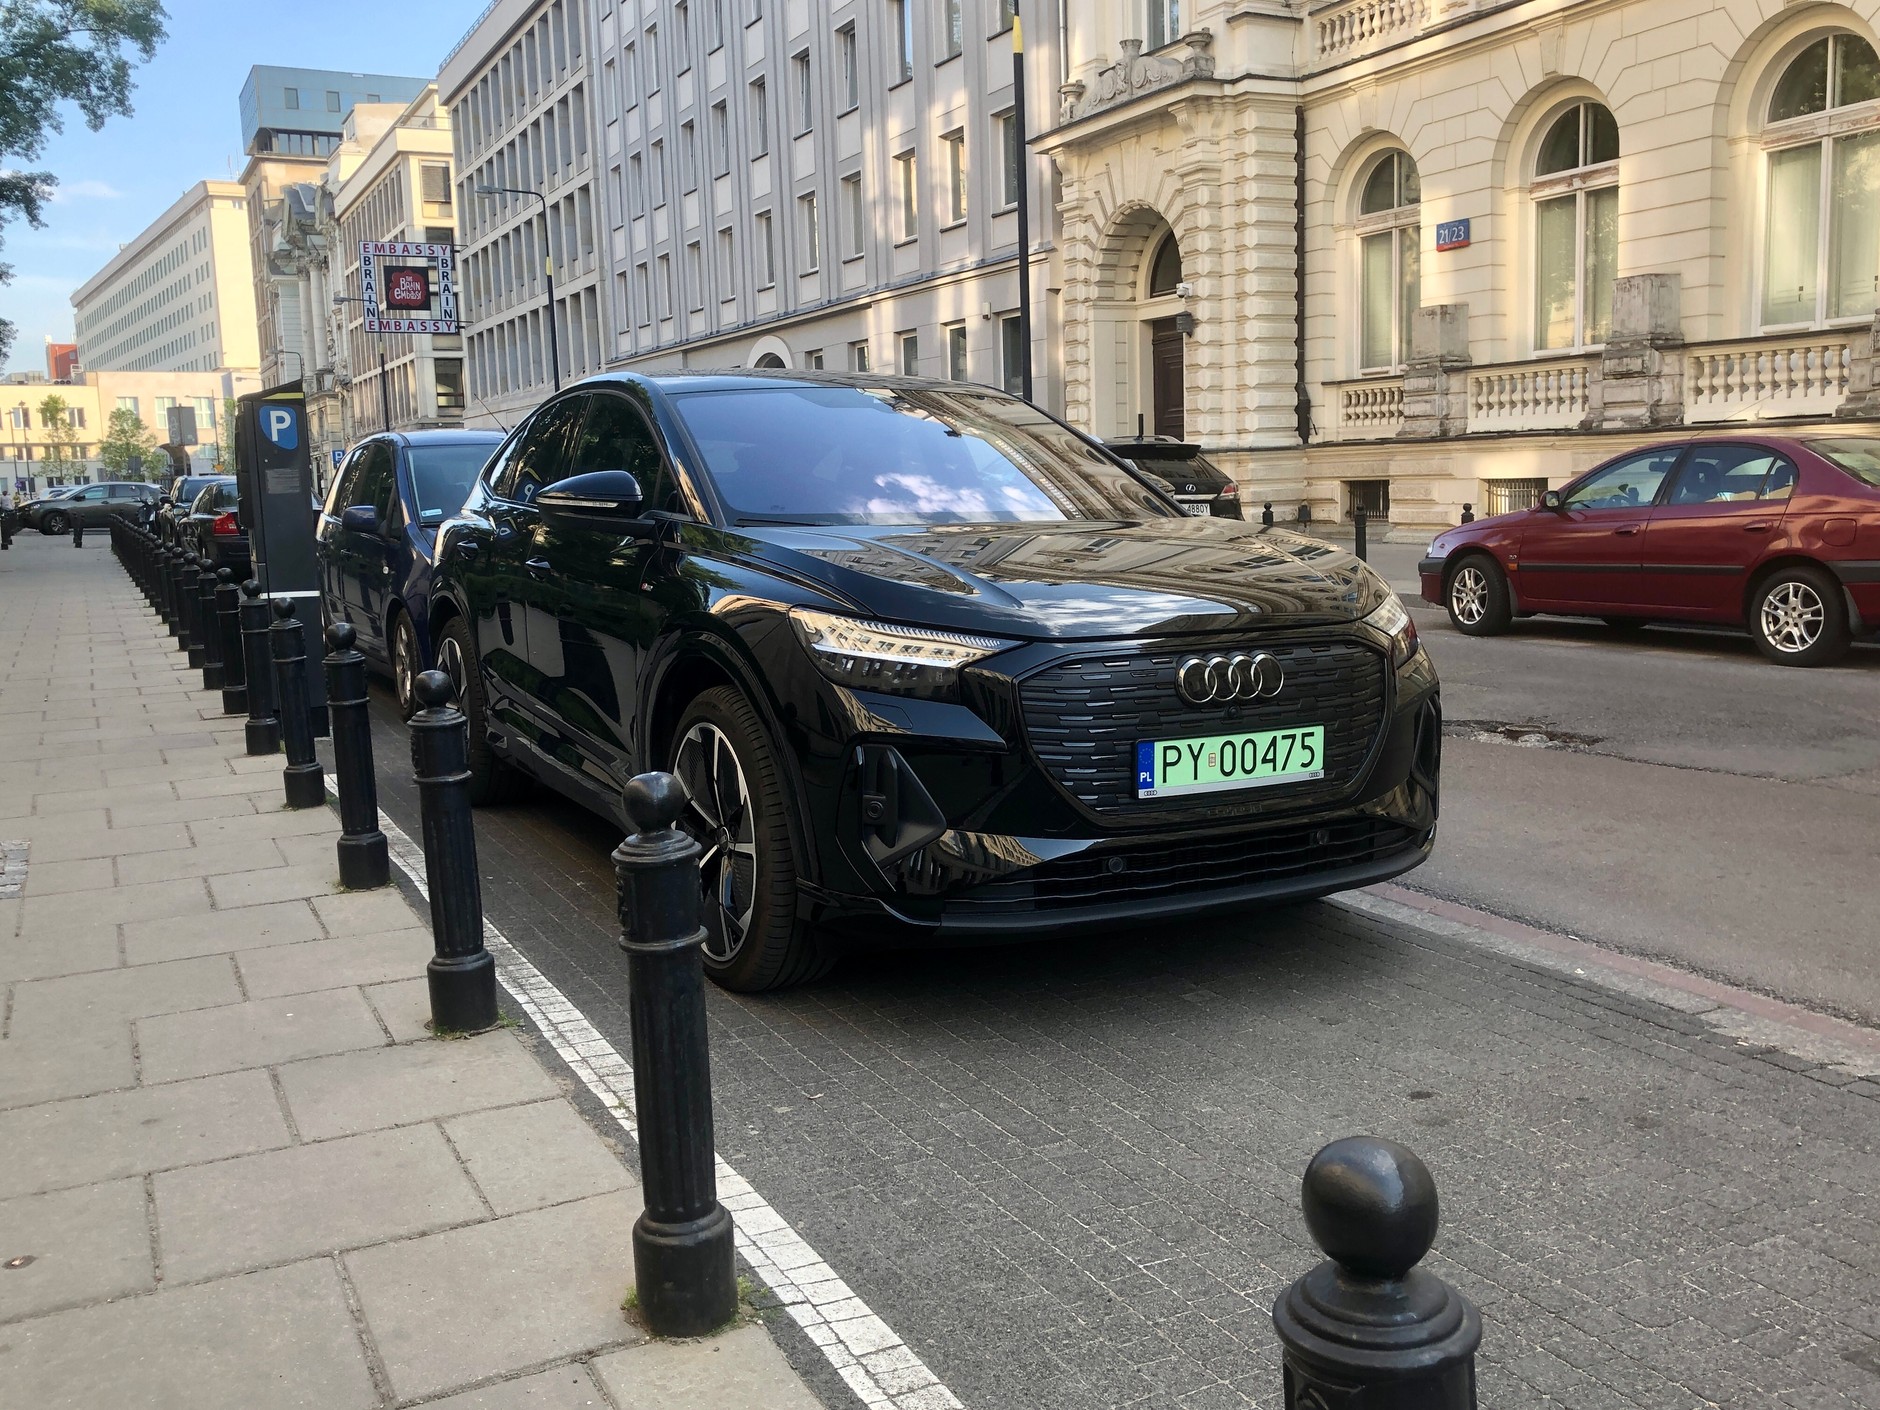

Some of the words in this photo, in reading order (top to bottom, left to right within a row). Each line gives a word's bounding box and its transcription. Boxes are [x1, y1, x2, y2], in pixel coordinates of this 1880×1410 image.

[1439, 226, 1465, 244] 21/23
[363, 243, 448, 256] EMBASSY
[363, 256, 376, 317] BRAIN
[441, 258, 453, 319] BRAIN
[368, 320, 453, 332] EMBASSY
[270, 410, 291, 442] P
[334, 451, 343, 462] P
[1140, 772, 1153, 783] PL
[1162, 742, 1206, 783] PY
[1219, 731, 1315, 777] 00475
